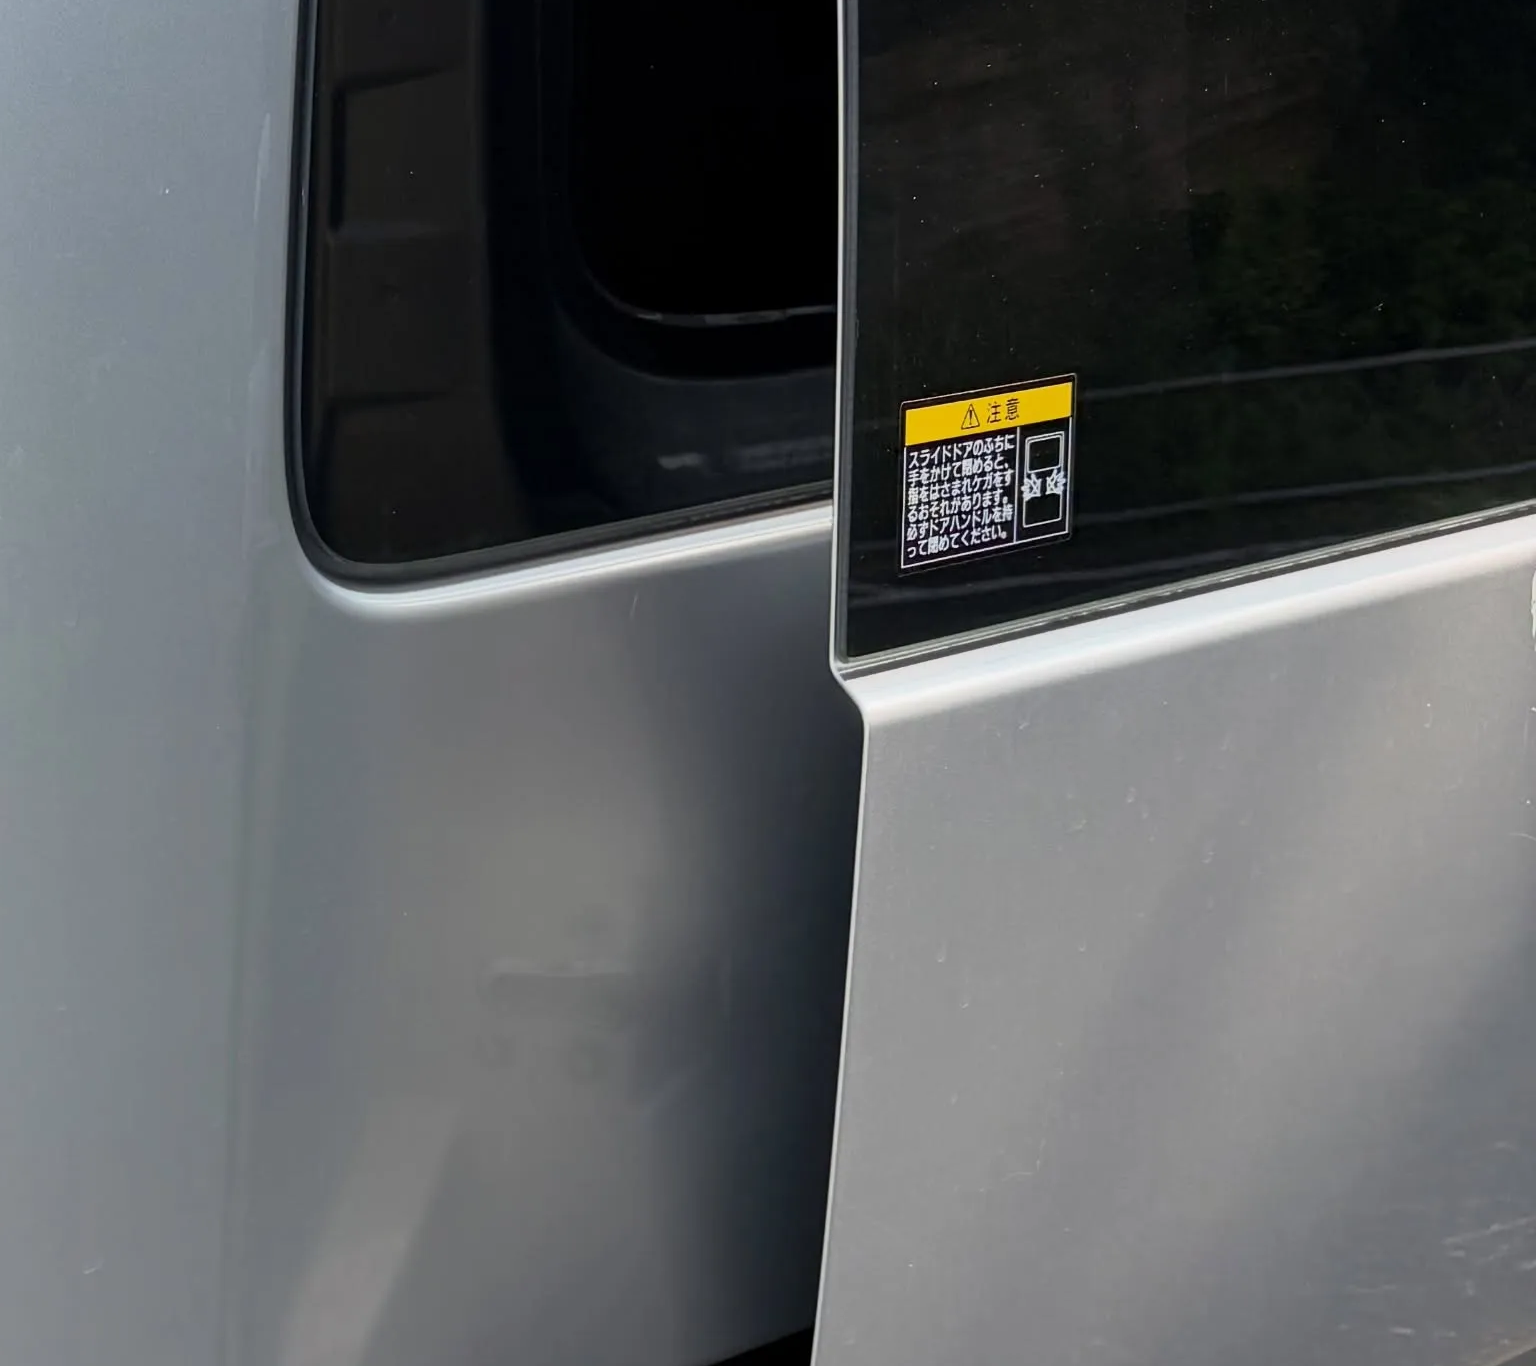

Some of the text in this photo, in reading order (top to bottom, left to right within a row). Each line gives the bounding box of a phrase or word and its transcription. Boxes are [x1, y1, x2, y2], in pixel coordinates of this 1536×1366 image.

[986, 398, 1020, 423] 注意
[908, 434, 1015, 469] スライドドアのふちに
[906, 503, 1013, 541] 必ずドアハンドルを持
[907, 488, 1009, 522] るおそれがあります。
[907, 525, 1007, 558] って閉めてください。
